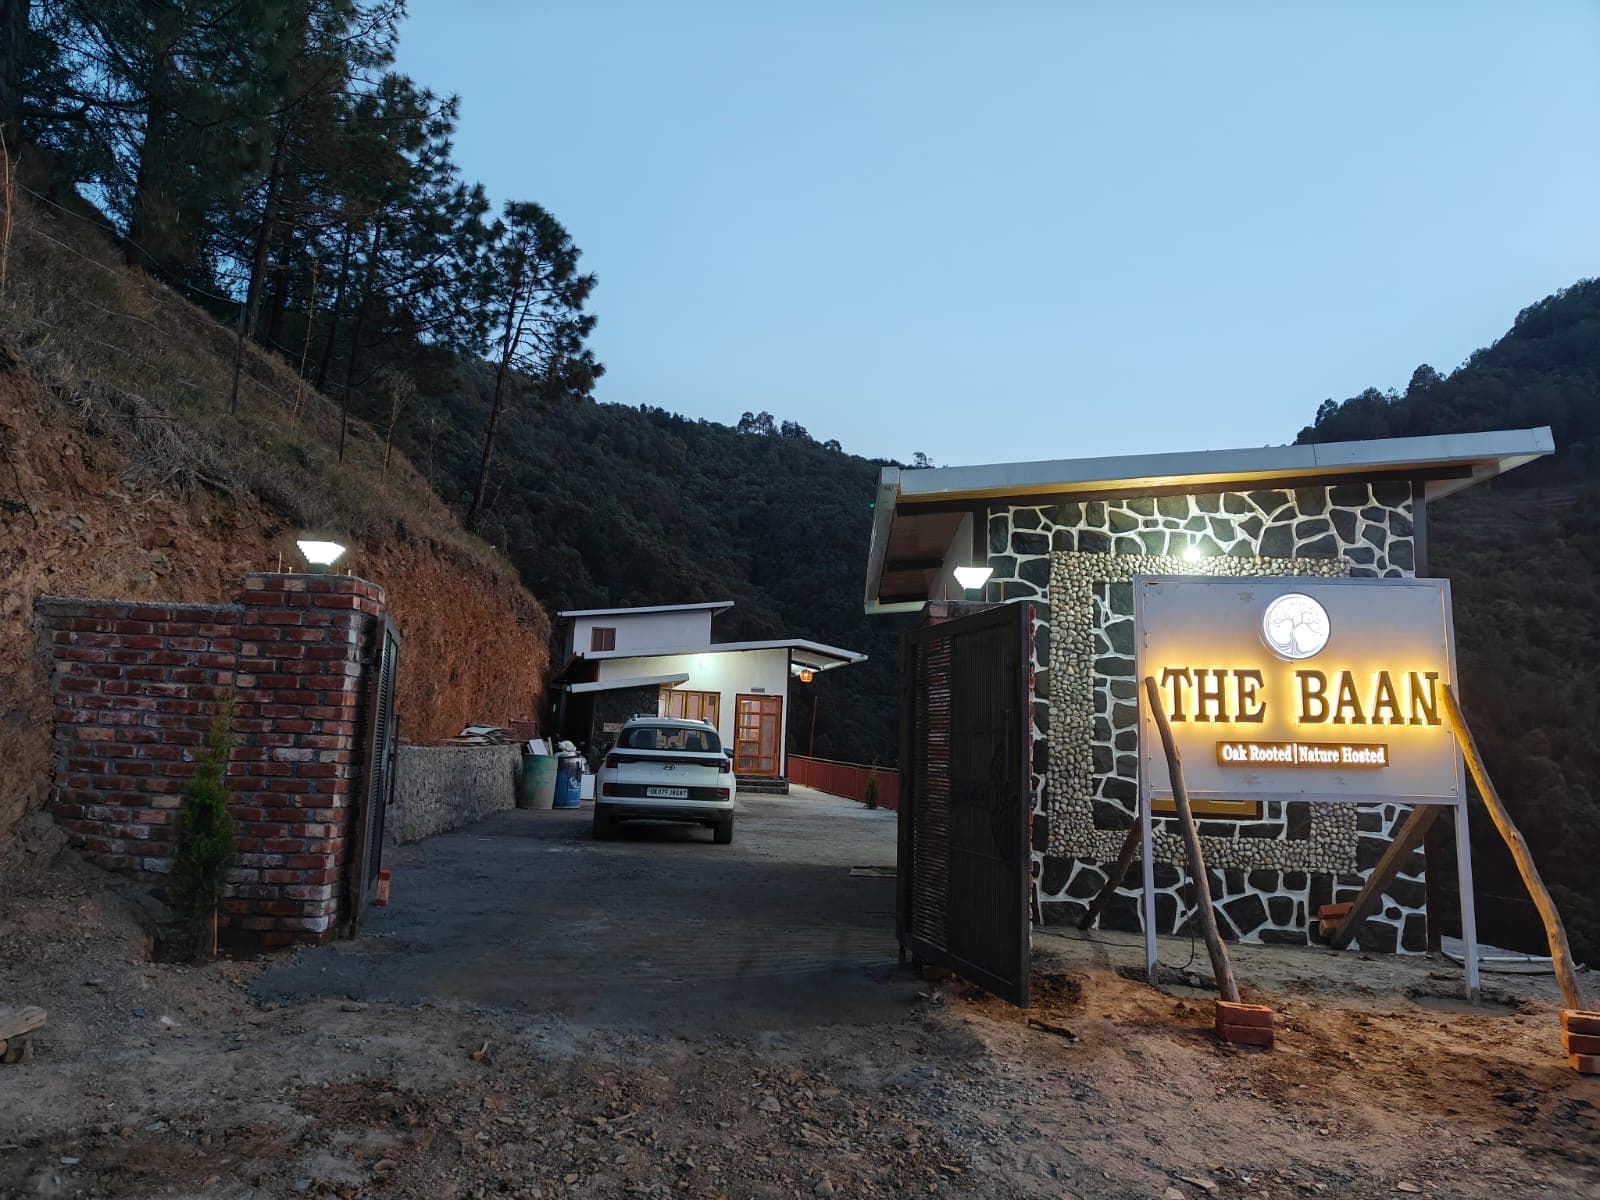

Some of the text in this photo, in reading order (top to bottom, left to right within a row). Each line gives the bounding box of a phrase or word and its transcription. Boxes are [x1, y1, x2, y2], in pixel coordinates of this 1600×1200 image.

[1160, 666, 1442, 726] THE BAAN
[1223, 744, 1247, 761] Oak
[1249, 744, 1292, 762] Rooted
[1299, 745, 1340, 763] Nature
[1341, 745, 1386, 764] Hosted
